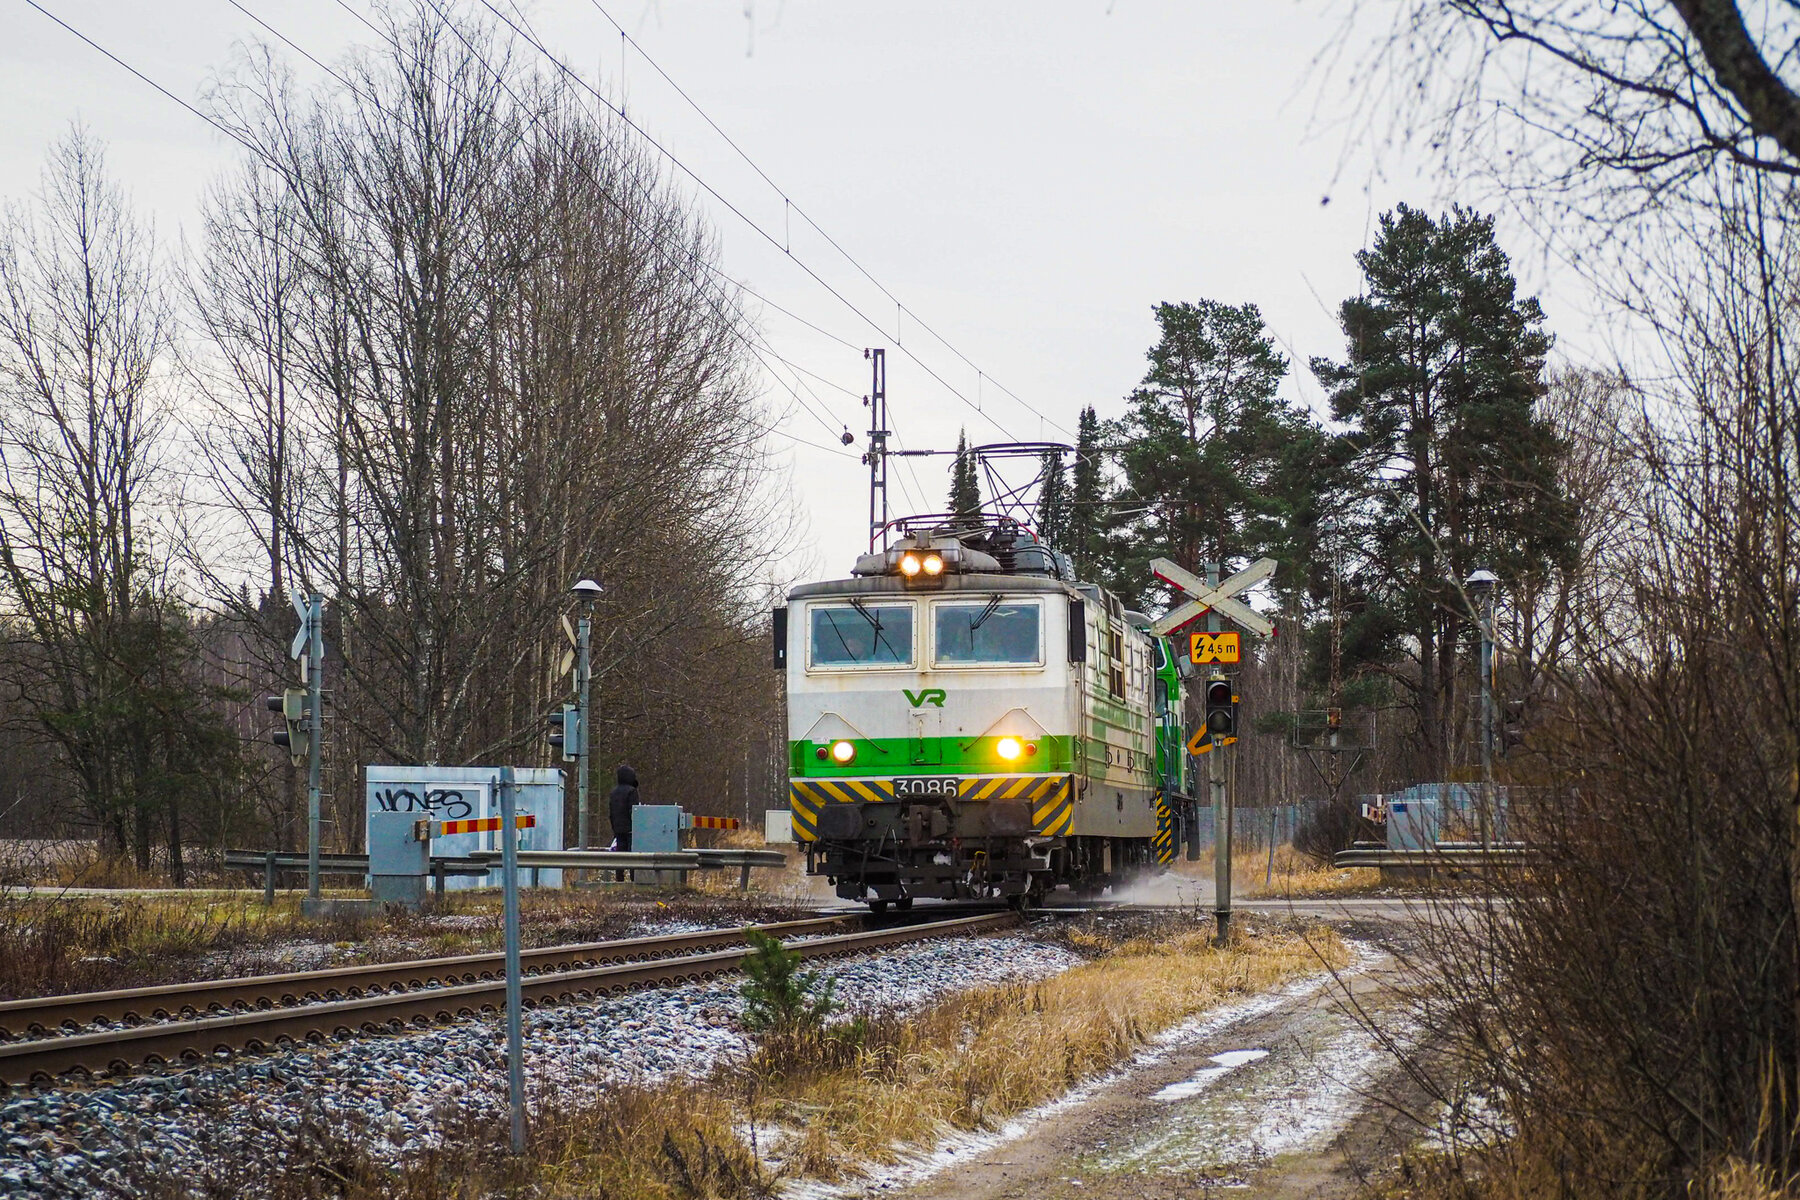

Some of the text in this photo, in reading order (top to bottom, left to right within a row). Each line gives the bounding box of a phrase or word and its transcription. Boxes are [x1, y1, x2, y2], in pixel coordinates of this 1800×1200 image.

[1208, 643, 1236, 655] 4,5 m
[902, 689, 947, 708] VR
[895, 780, 957, 799] 3086
